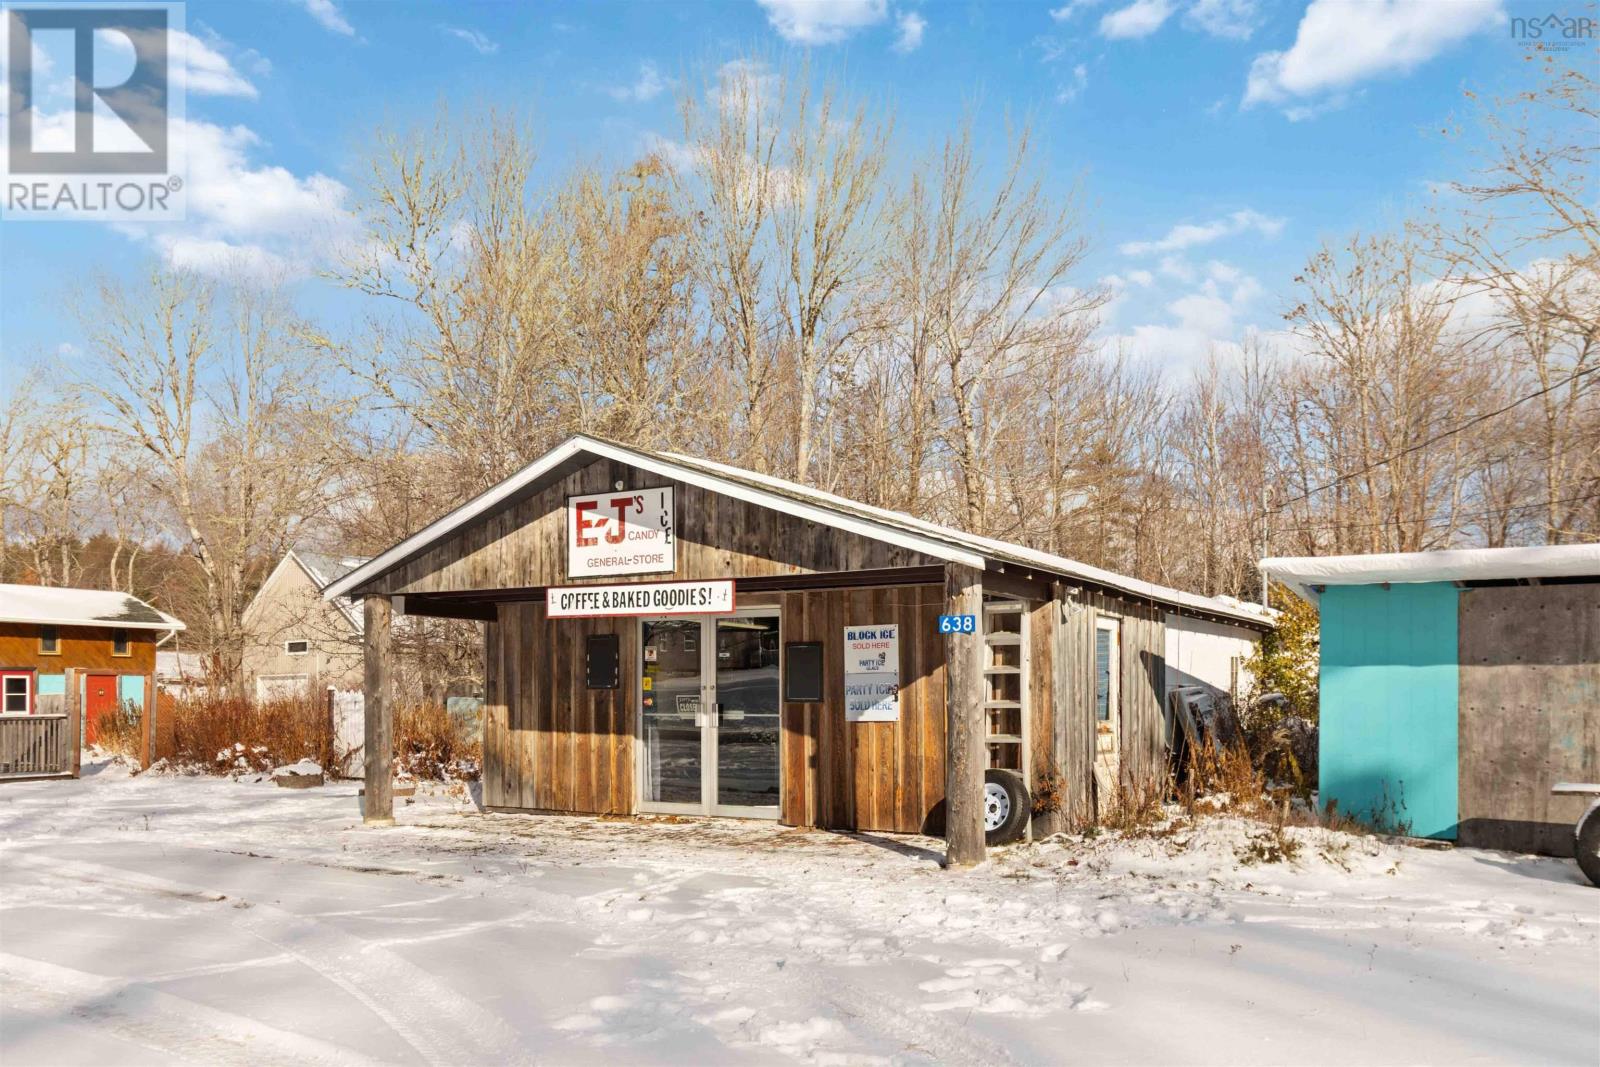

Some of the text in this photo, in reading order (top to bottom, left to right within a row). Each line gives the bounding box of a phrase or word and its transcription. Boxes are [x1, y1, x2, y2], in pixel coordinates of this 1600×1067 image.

[628, 529, 659, 541] CANDY
[602, 591, 610, 608] &
[612, 590, 650, 608] BAKED
[653, 587, 712, 607] GOODIES!
[941, 616, 973, 632] 638
[847, 629, 895, 640] BLOCK ICE
[852, 641, 890, 650] SOLD HERE
[846, 684, 872, 695] PARTY
